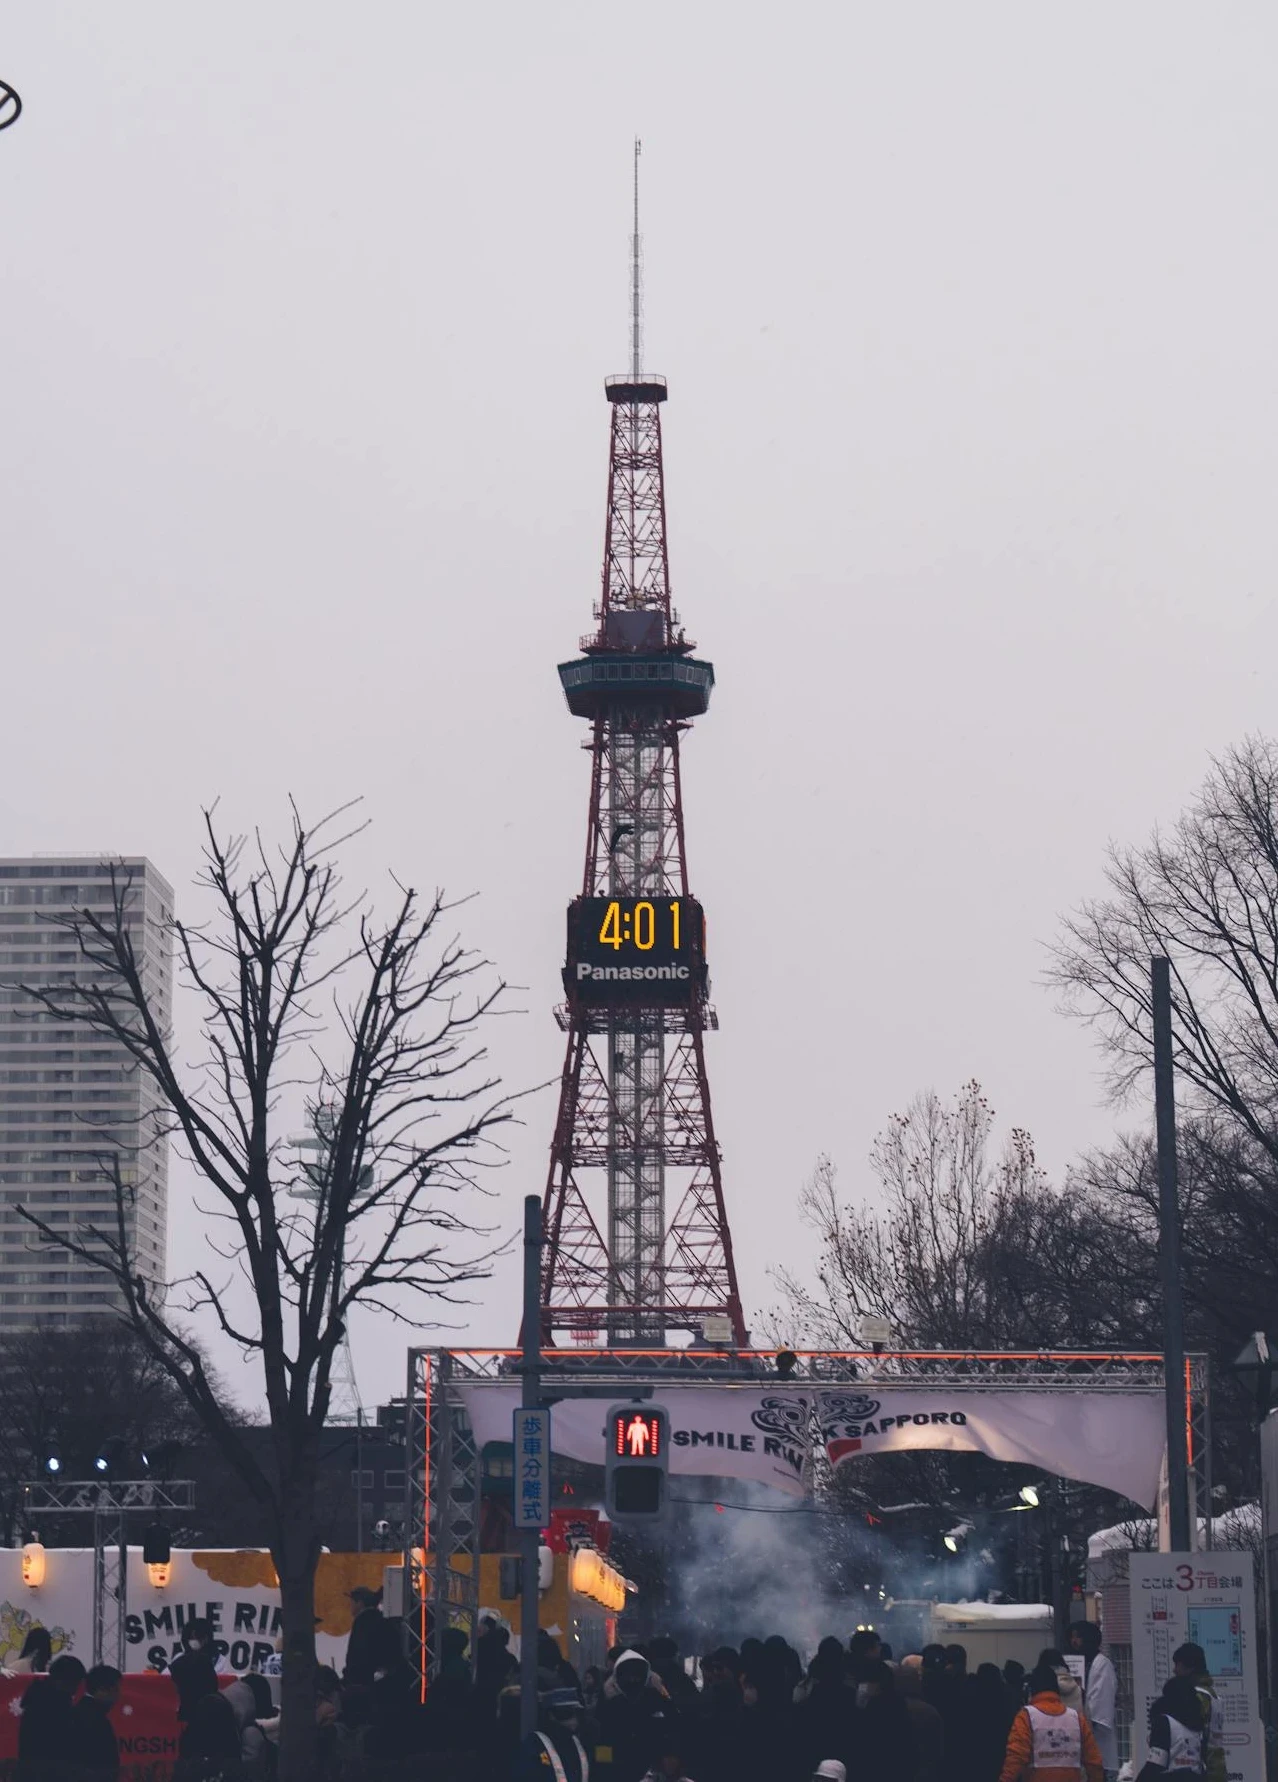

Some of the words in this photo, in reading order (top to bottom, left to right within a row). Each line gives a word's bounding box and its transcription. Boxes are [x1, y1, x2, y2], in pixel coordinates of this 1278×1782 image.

[599, 901, 680, 950] 4:01
[576, 962, 690, 980] Panasonic
[673, 1429, 756, 1452] SMILE
[843, 1411, 967, 1438] SAPPORO
[522, 1416, 542, 1521] 歩車分離式
[125, 1601, 224, 1644] SMILE
[234, 1602, 283, 1637] RIN
